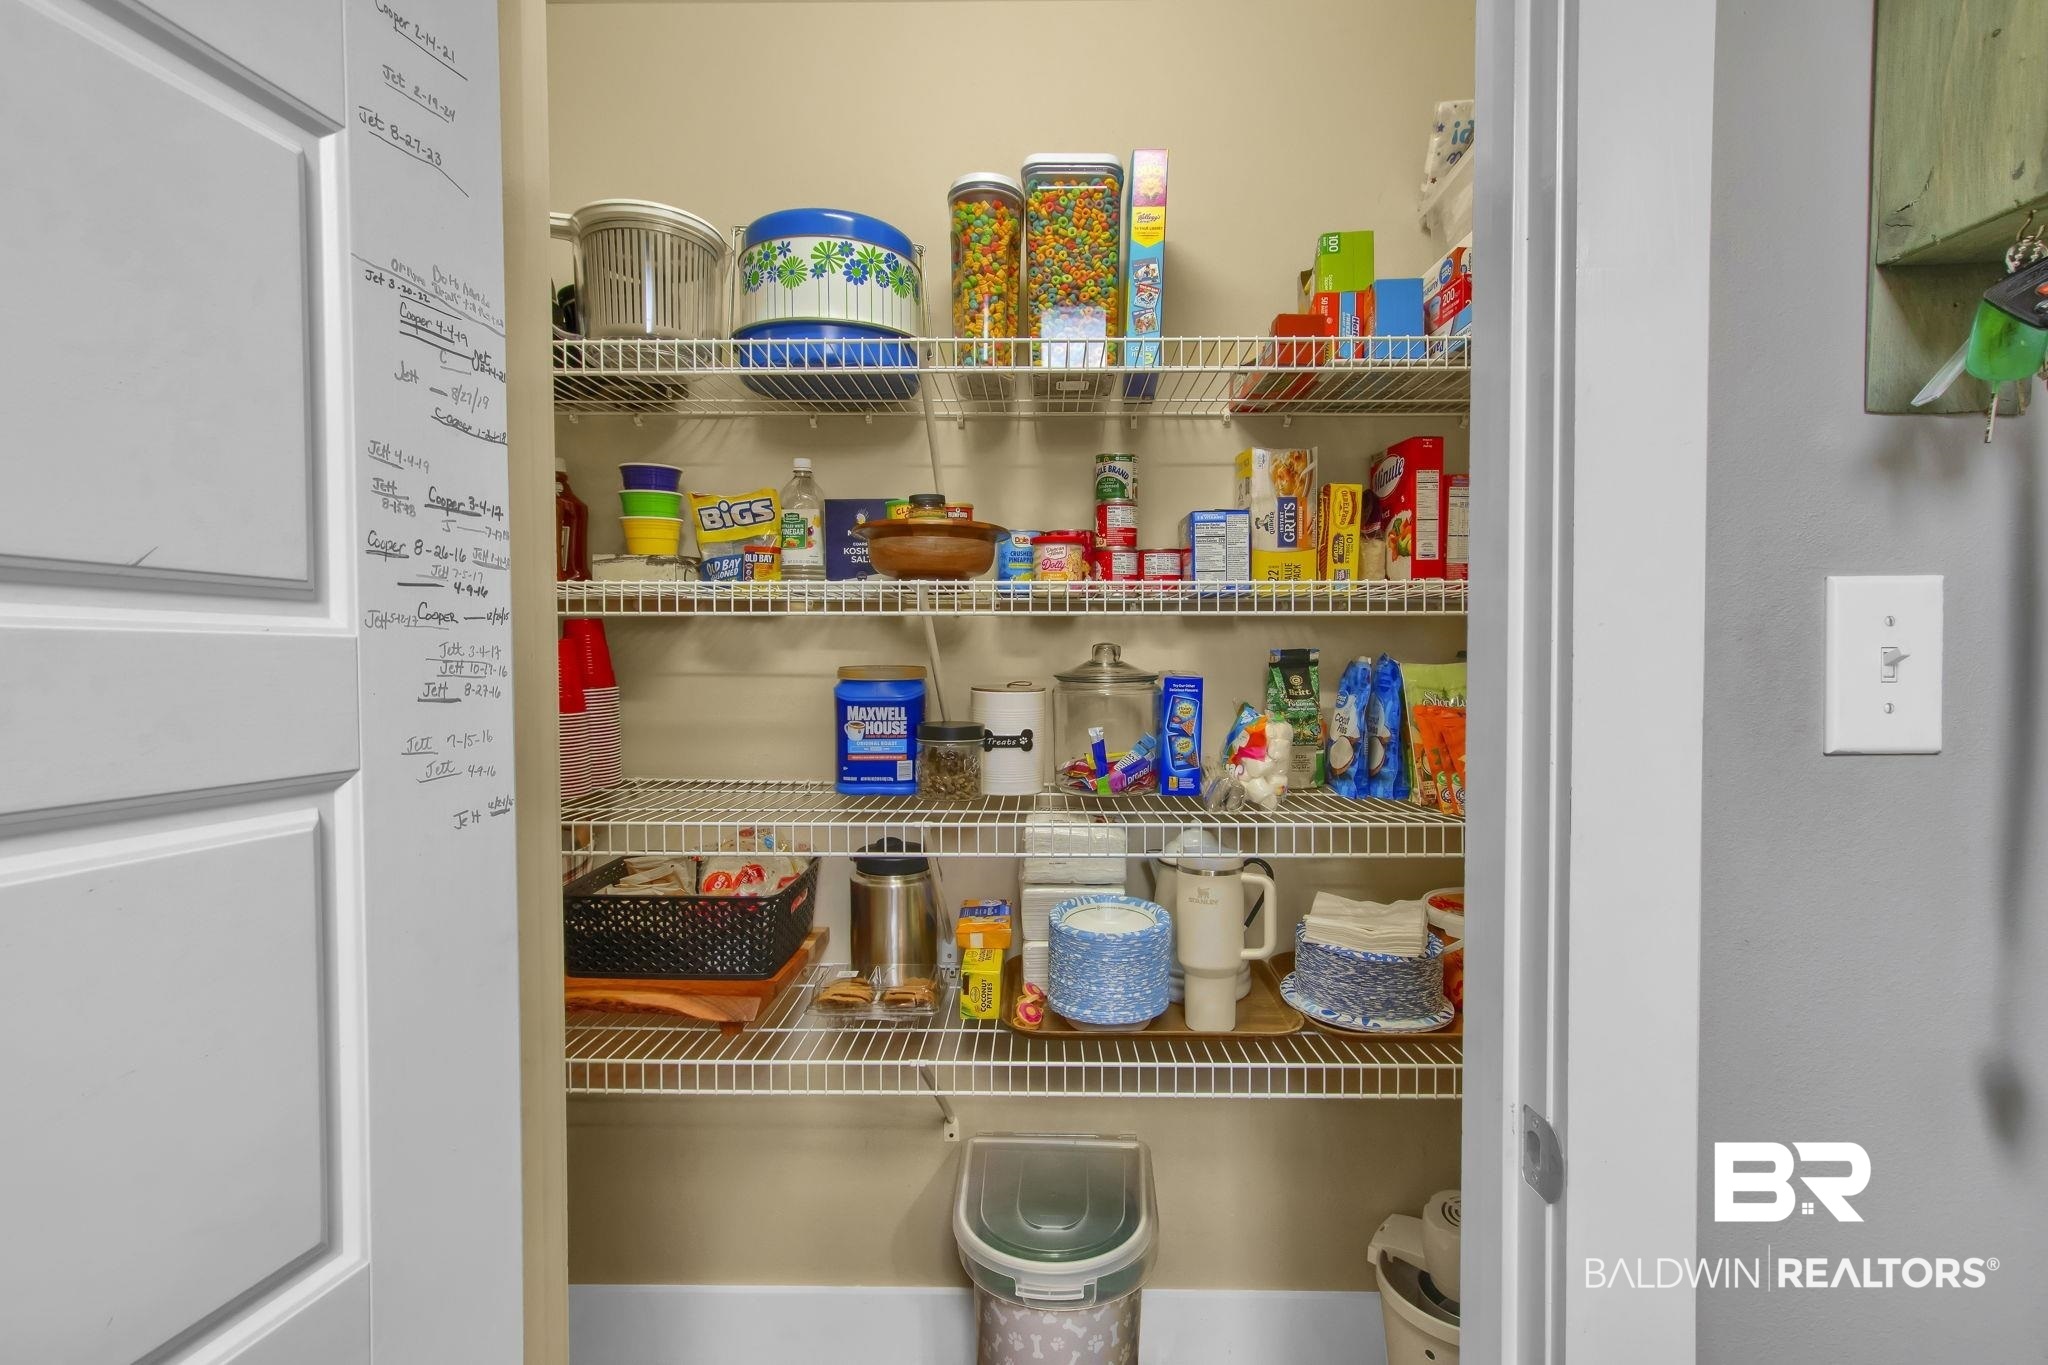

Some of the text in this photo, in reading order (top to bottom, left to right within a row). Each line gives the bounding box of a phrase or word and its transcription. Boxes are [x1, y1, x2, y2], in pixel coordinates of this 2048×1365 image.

[375, 0, 456, 63] Cooper 2-14-21
[383, 64, 456, 122] Jet 2-19-24
[358, 106, 442, 166] Jet 8-27-23
[1328, 234, 1339, 253] 100
[365, 269, 385, 285] Jet
[1321, 296, 1328, 305] 50
[1442, 288, 1455, 306] 200
[400, 302, 433, 333] Cooper
[1351, 316, 1360, 338] Heft
[472, 349, 492, 371] Jet
[451, 384, 490, 414] 8/27/19
[1107, 464, 1130, 480] BRAND
[1374, 457, 1404, 492] Minute
[428, 486, 465, 516] Cooper
[1283, 502, 1296, 542] GRITS
[367, 530, 467, 563] Cooper 8-26-16
[1346, 533, 1353, 544] 10
[745, 553, 773, 563] OLD BAY
[843, 547, 869, 555] KOSH
[706, 557, 741, 577] OLD BAY
[1041, 558, 1066, 570] Dolly
[1284, 562, 1293, 580] ALUE
[438, 641, 501, 660] Jett 3-4-17
[440, 660, 464, 675] Jett
[422, 681, 501, 699] Jett 8-27-16
[1289, 688, 1311, 696] Britt
[847, 705, 908, 720] MAXWELL
[865, 721, 908, 735] HOUSE
[406, 729, 493, 752] Jett 7-15-16
[987, 737, 1017, 746] Treats
[425, 760, 496, 778] Jett 4-9-16
